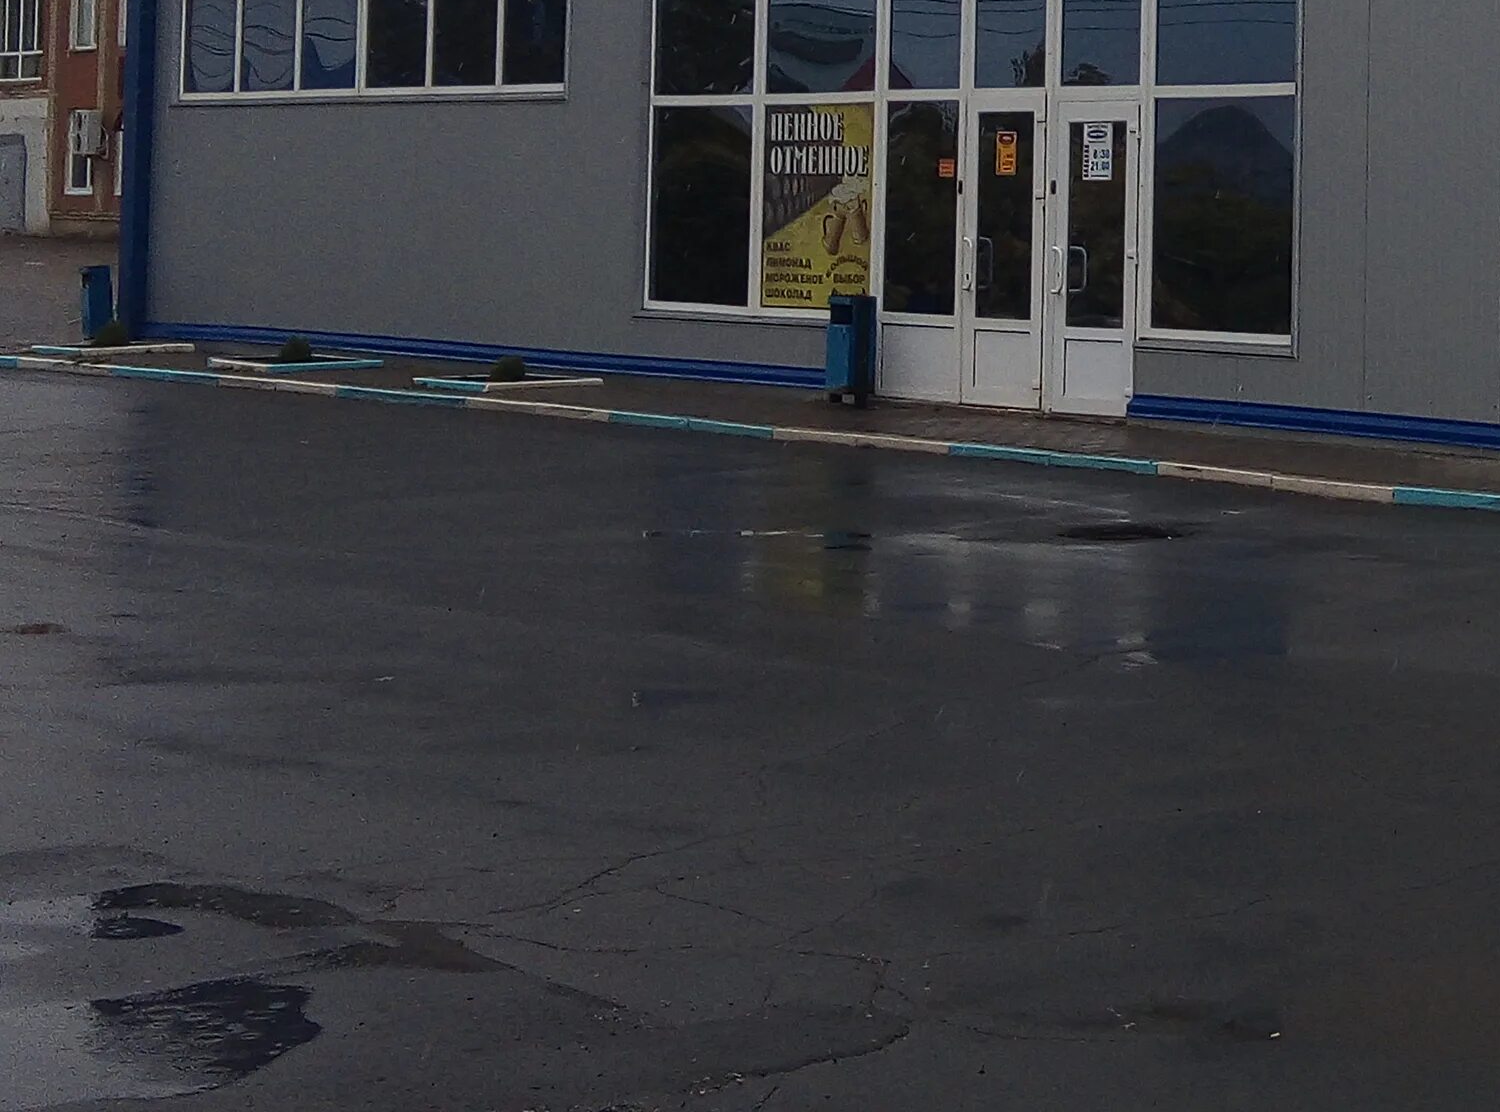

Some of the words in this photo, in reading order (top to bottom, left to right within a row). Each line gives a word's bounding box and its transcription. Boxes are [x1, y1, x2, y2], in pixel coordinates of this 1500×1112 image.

[770, 112, 845, 142] ПЕННОЕ
[770, 145, 870, 177] ОТМЕННОЕ
[764, 288, 812, 301] ШОКОЛАД
